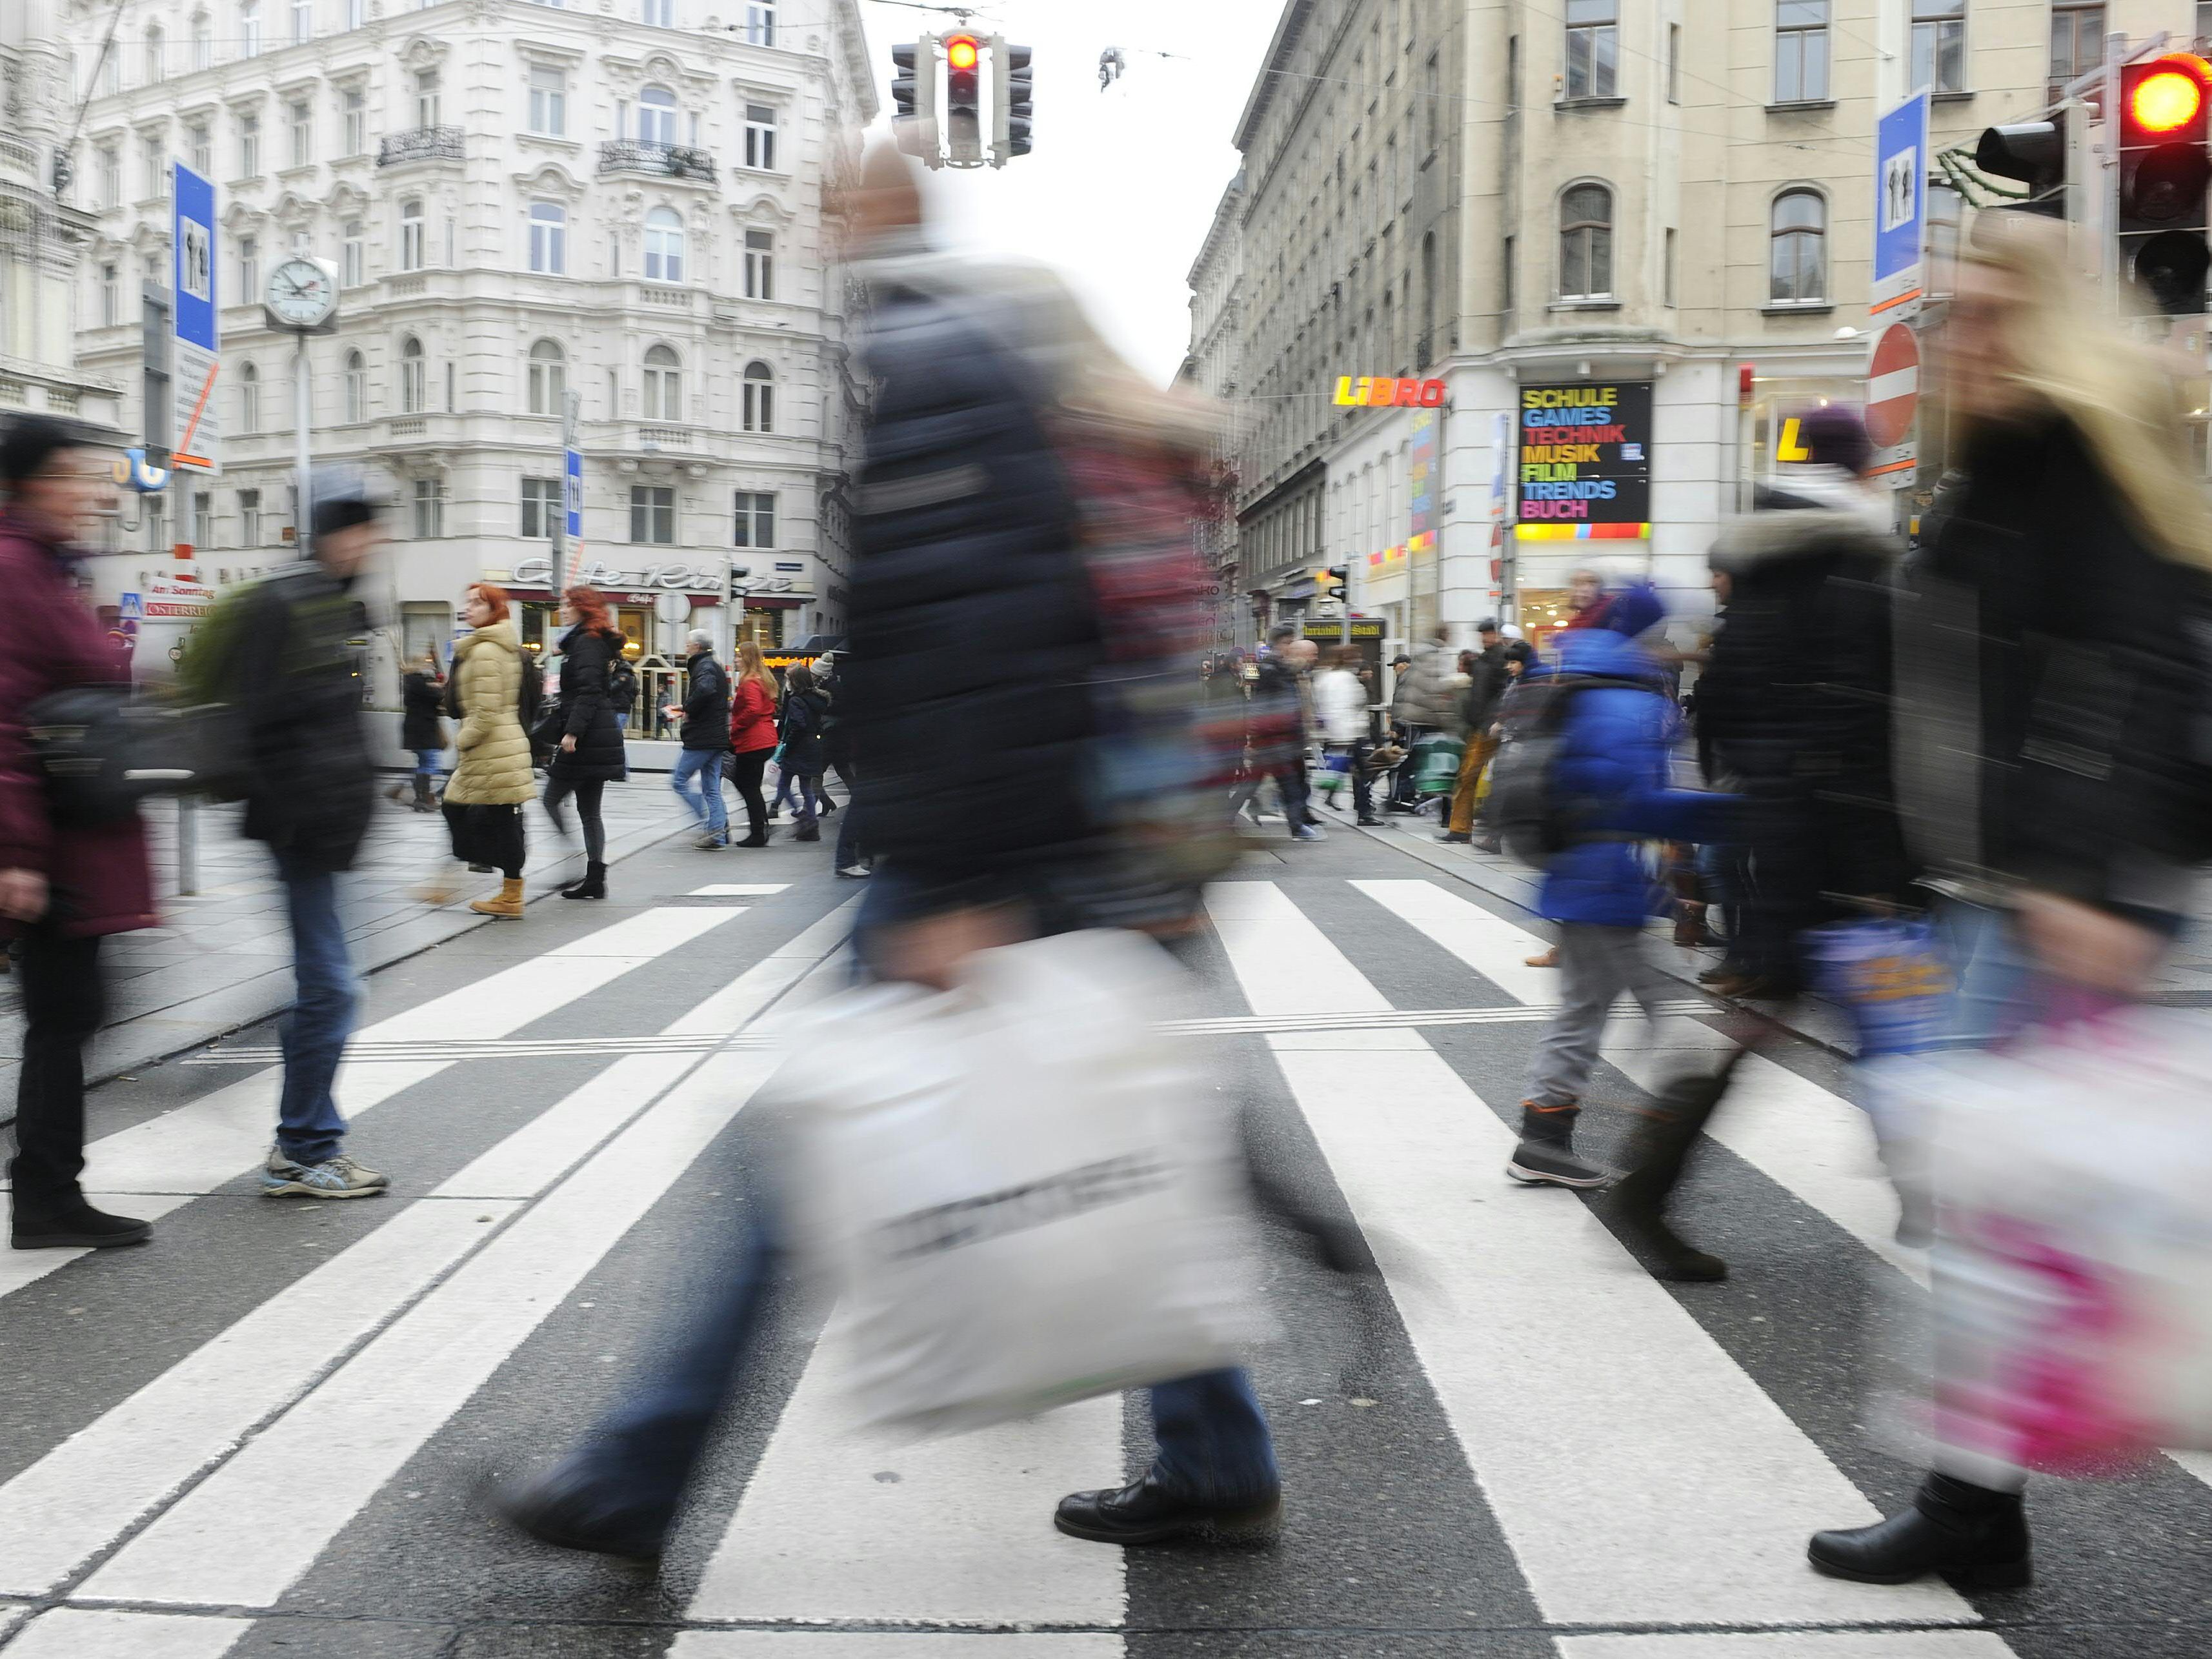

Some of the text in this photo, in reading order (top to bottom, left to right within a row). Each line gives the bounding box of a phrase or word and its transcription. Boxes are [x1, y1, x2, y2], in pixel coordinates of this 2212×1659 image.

[1522, 387, 1618, 408] SCHULE
[1523, 407, 1611, 427] GAMES
[1523, 424, 1627, 445] TECHNIK
[1521, 444, 1601, 463] MUSIK
[1520, 463, 1576, 482] FILM
[1521, 480, 1616, 500] TRENDS
[1521, 500, 1588, 518] BUCH
[171, 585, 216, 599] Sonntag
